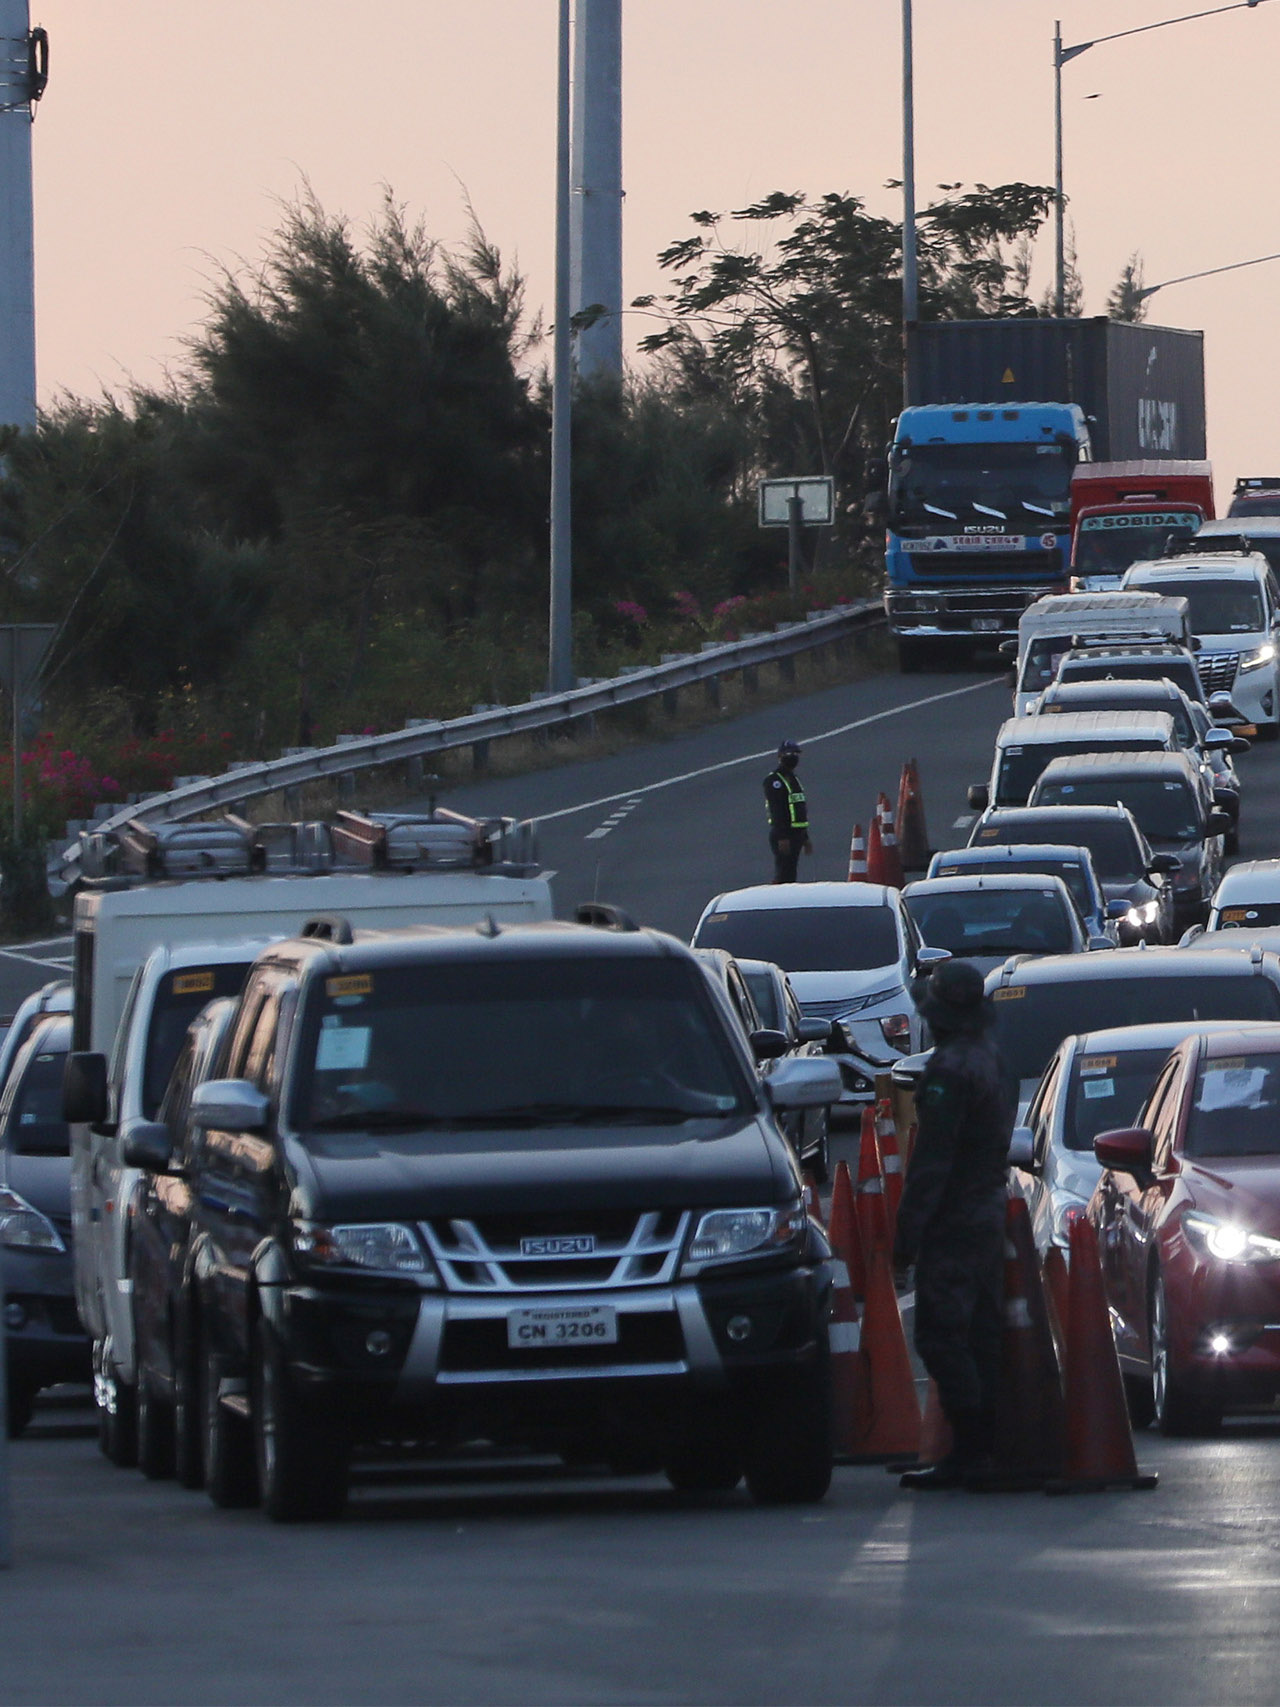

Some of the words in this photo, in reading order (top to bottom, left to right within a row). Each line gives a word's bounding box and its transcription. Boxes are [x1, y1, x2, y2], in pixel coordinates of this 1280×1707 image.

[1102, 515, 1178, 528] SOBIDA
[963, 525, 1005, 534] ISUZU
[1042, 535, 1055, 546] 45
[525, 1238, 590, 1254] ISUZU
[518, 1324, 546, 1340] CN
[556, 1322, 606, 1338] 3206
